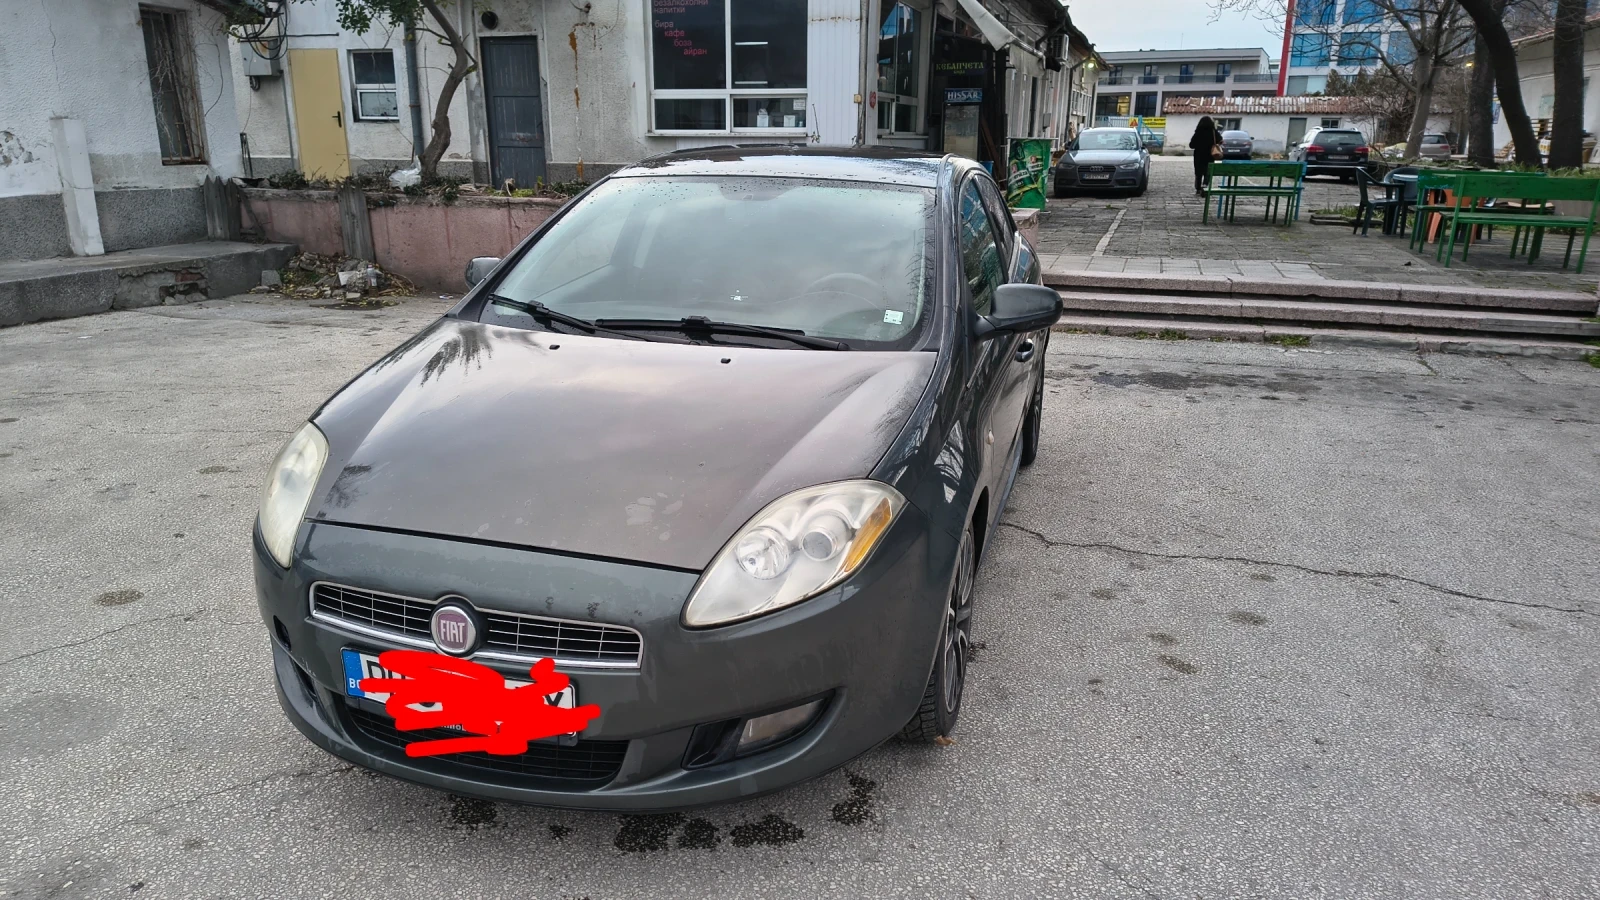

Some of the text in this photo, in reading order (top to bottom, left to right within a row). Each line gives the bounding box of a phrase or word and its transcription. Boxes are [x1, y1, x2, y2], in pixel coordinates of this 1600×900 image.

[655, 20, 674, 28] бира
[664, 29, 685, 38] кафе
[683, 47, 707, 56] айран
[947, 90, 979, 101] HISSAR
[440, 619, 466, 643] FIAT
